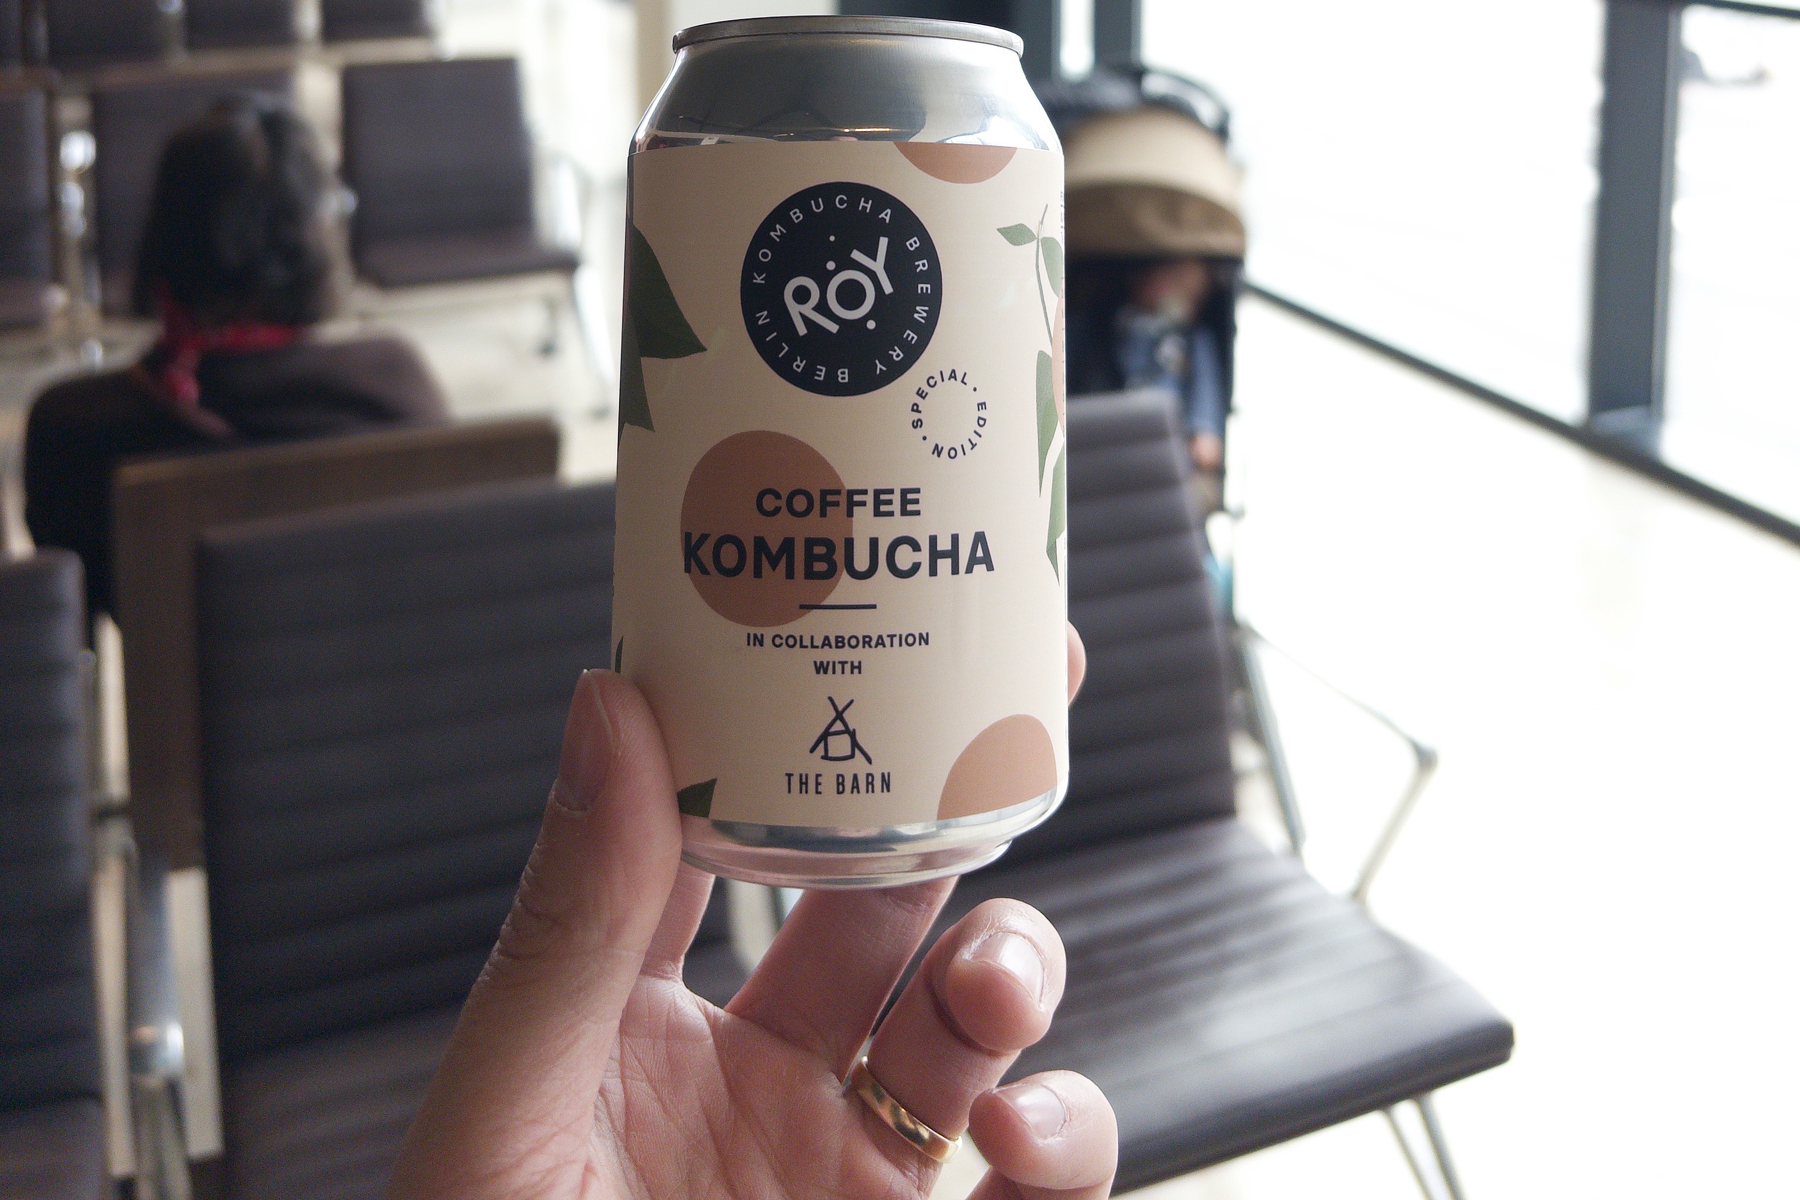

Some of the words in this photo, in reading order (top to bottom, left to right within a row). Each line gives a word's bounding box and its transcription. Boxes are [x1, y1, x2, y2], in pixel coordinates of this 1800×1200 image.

[753, 195, 892, 284] KOMBUCHA
[874, 236, 931, 374] BREWERY
[756, 310, 849, 382] BERLIN
[911, 369, 967, 430] SPECIAL
[932, 401, 987, 460] EDITION
[756, 487, 921, 518] COFFEE
[683, 531, 995, 581] KOMBUCHA
[746, 632, 765, 648] IN
[771, 632, 930, 649] COLLABORATION
[813, 661, 862, 675] WITH
[785, 772, 822, 795] THE
[836, 771, 891, 795] BARN
